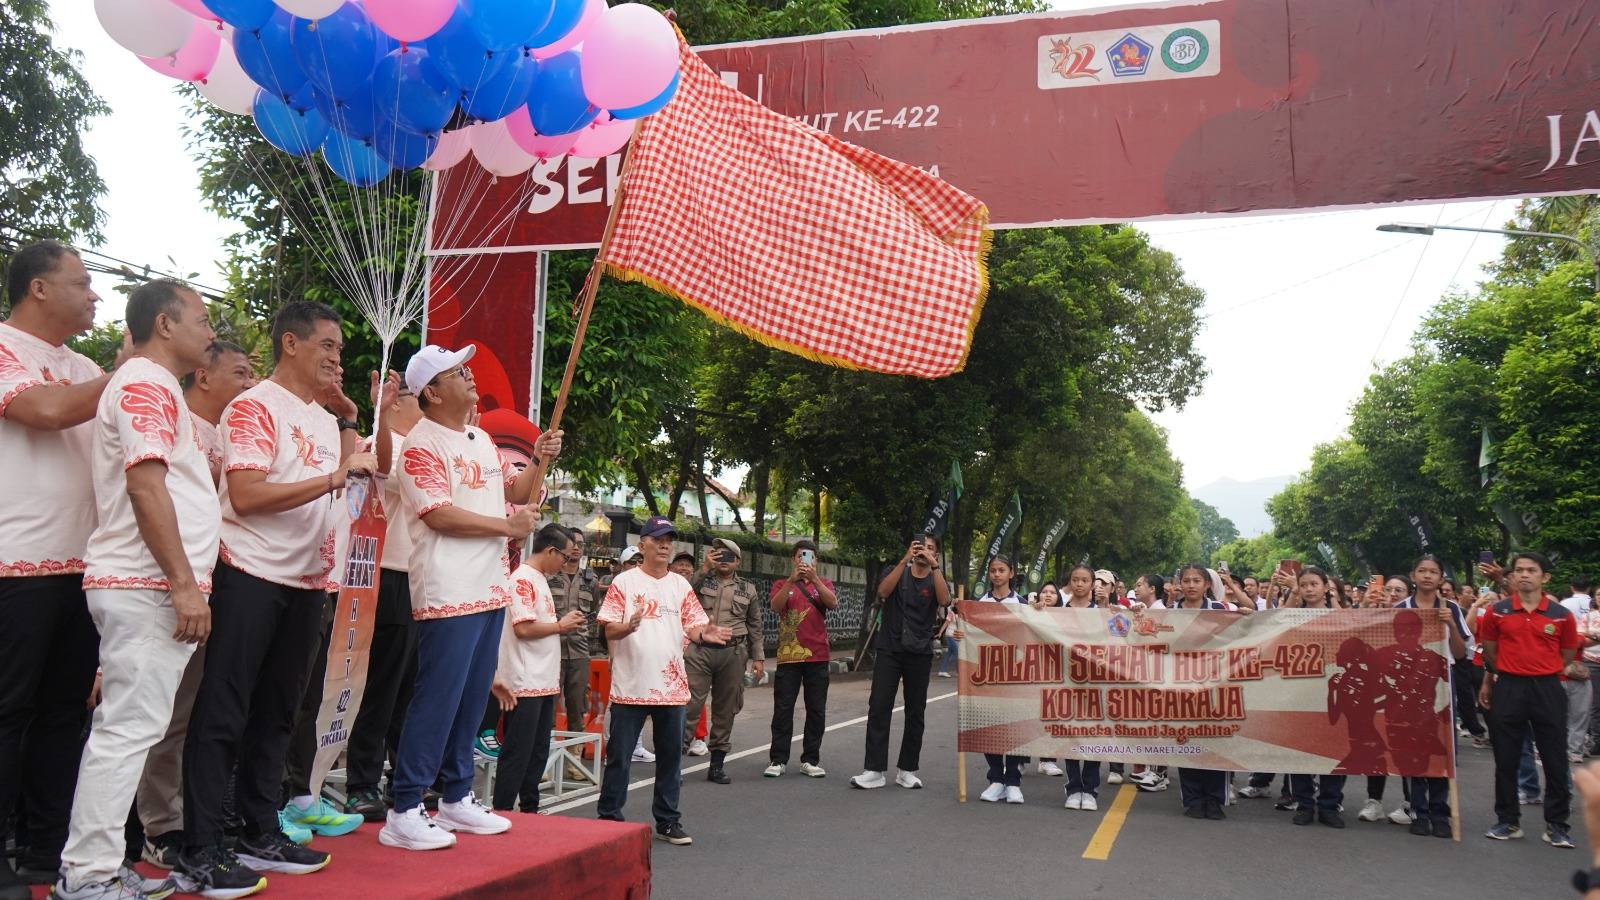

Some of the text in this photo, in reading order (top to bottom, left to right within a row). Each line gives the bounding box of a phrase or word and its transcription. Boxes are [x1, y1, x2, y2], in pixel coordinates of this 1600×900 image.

[844, 105, 940, 133] KE-422
[1000, 514, 1015, 537] BALI
[1034, 550, 1047, 571] BANK
[970, 642, 1326, 684] JALAN SEHAT HUT KE-422
[336, 688, 352, 714] 422
[1040, 685, 1246, 722] KOTA SINGARAJA
[1114, 724, 1159, 738] Shanti
[1079, 745, 1134, 755] SINGARAJA,
[1136, 745, 1142, 754] 6
[1144, 745, 1175, 755] MARET
[1177, 745, 1201, 755] 2026
